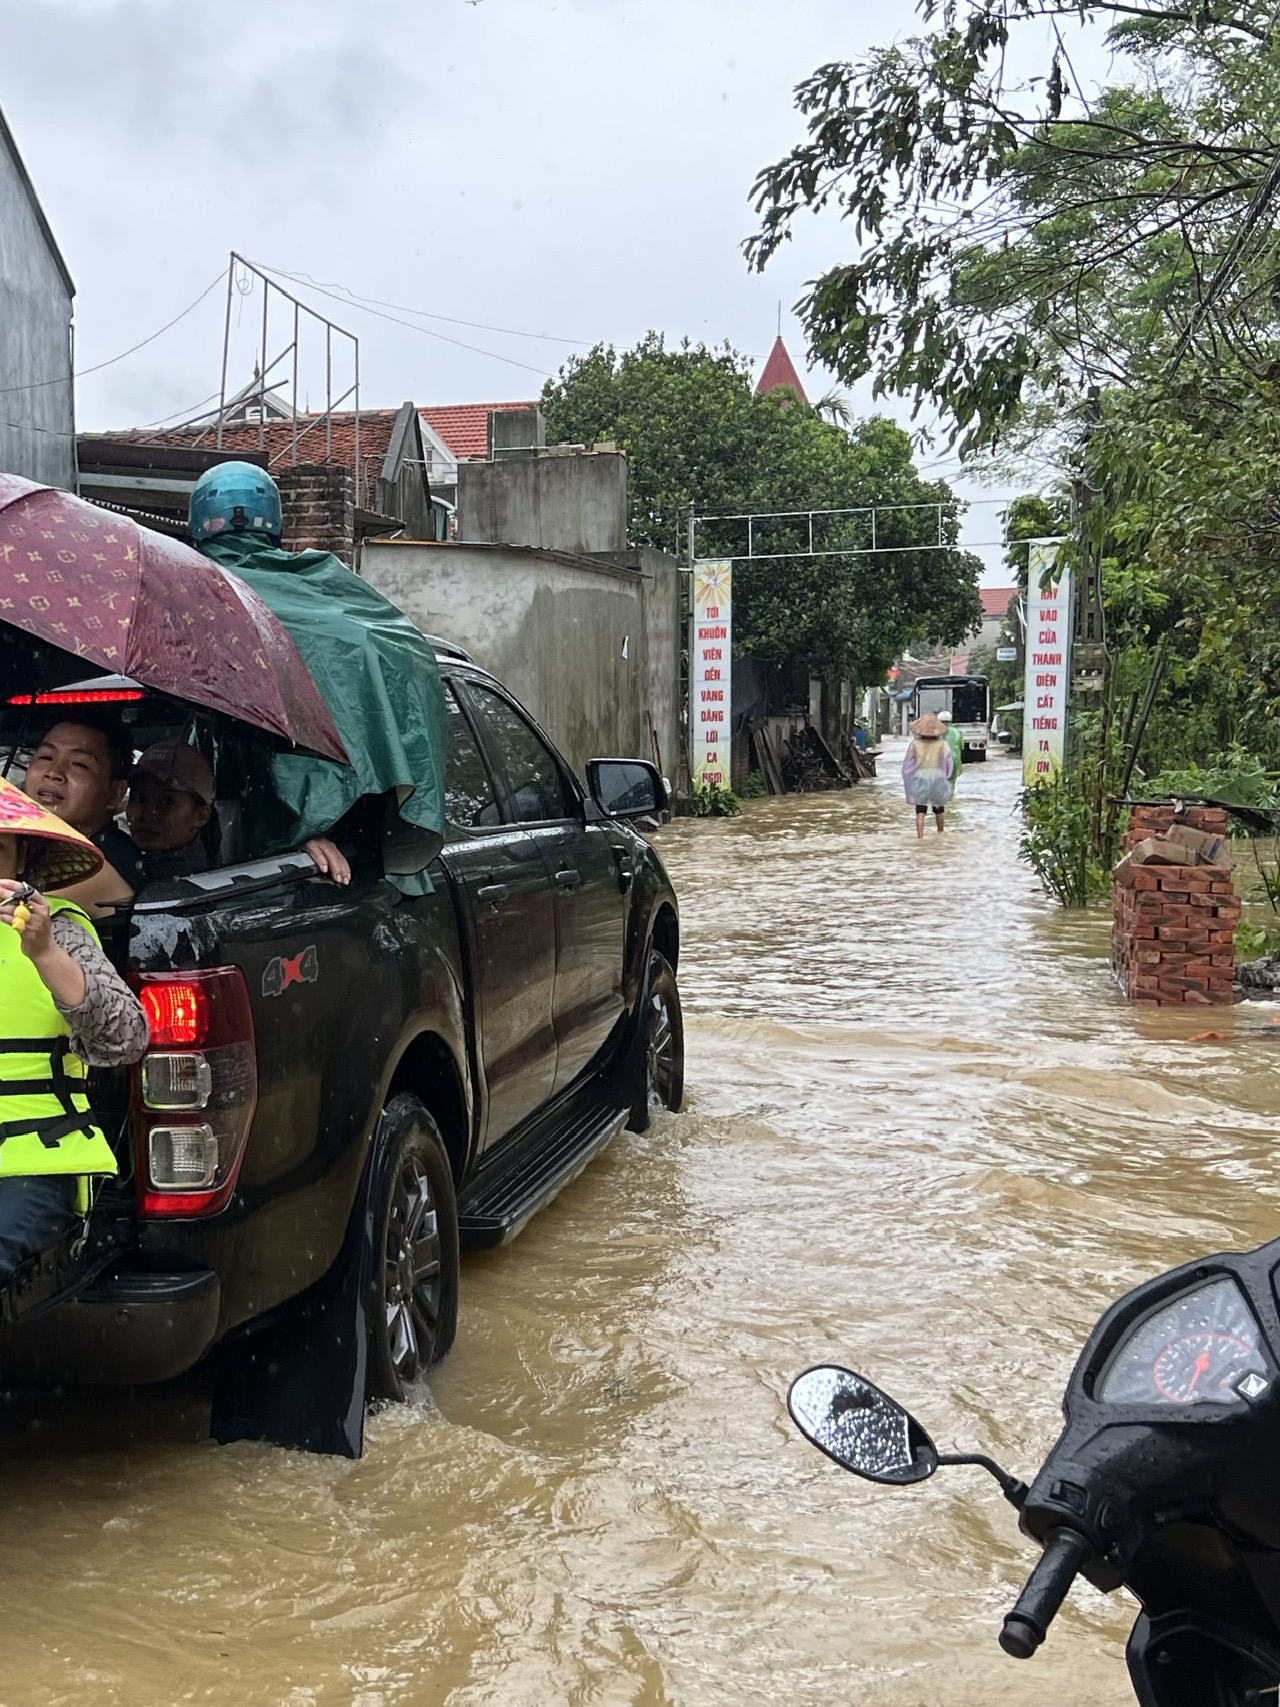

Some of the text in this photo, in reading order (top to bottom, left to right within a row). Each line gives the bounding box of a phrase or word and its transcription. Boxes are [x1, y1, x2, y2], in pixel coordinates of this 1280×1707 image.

[1040, 608, 1057, 622] VÀO
[698, 626, 727, 639] KHUÔN
[703, 647, 722, 660] VIÊN
[700, 688, 723, 701] VÀNG
[1032, 715, 1057, 730] TIẾNG
[1039, 740, 1049, 755] TẠ
[706, 752, 717, 763] CA
[1036, 760, 1050, 773] ƠN
